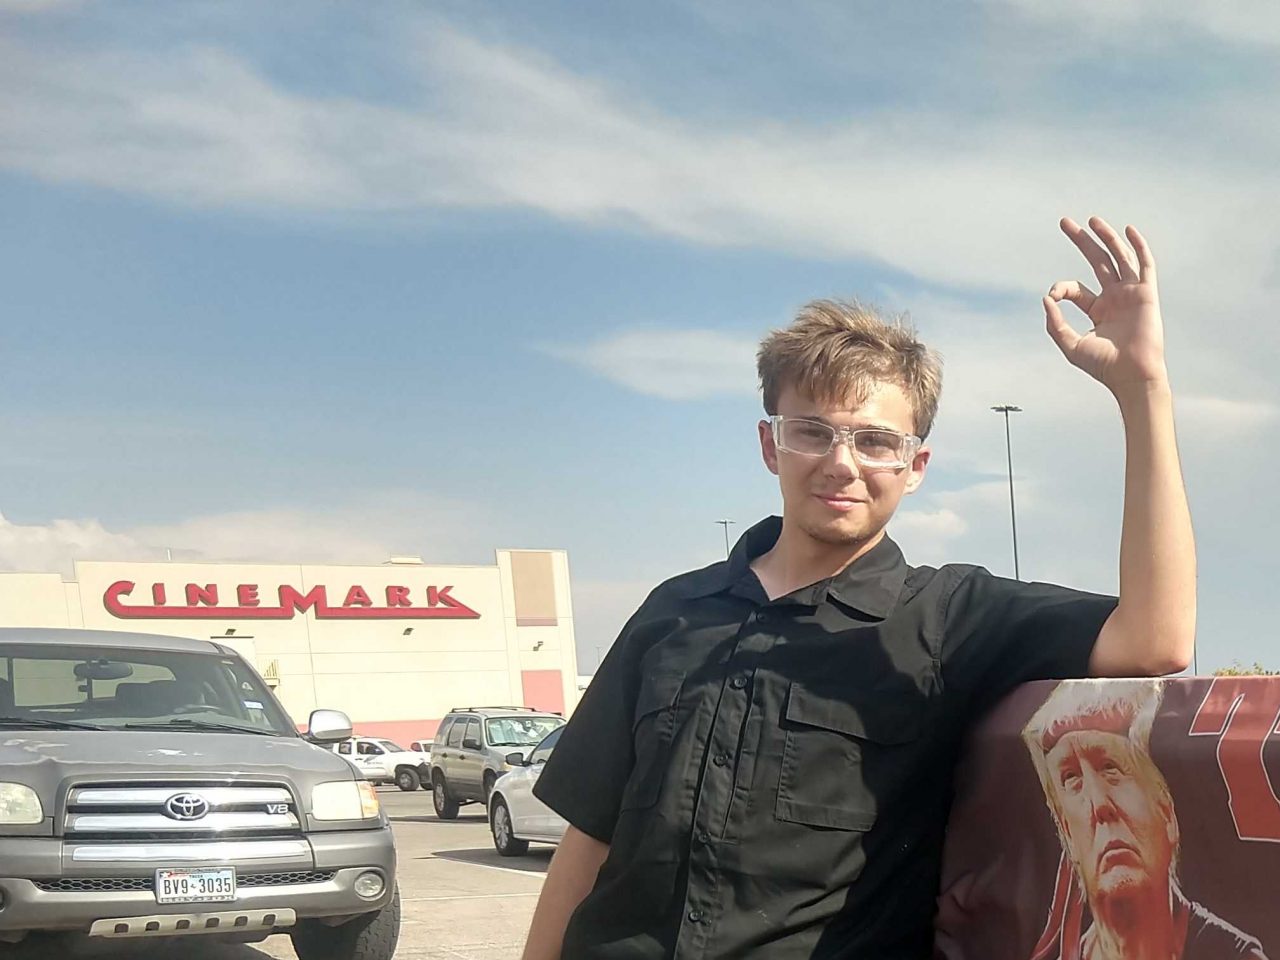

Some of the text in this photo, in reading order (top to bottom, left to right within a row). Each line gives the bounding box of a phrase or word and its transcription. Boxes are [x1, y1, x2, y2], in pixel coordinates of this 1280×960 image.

[103, 580, 481, 620] CINEMARK
[164, 878, 231, 895] BV9 3035
